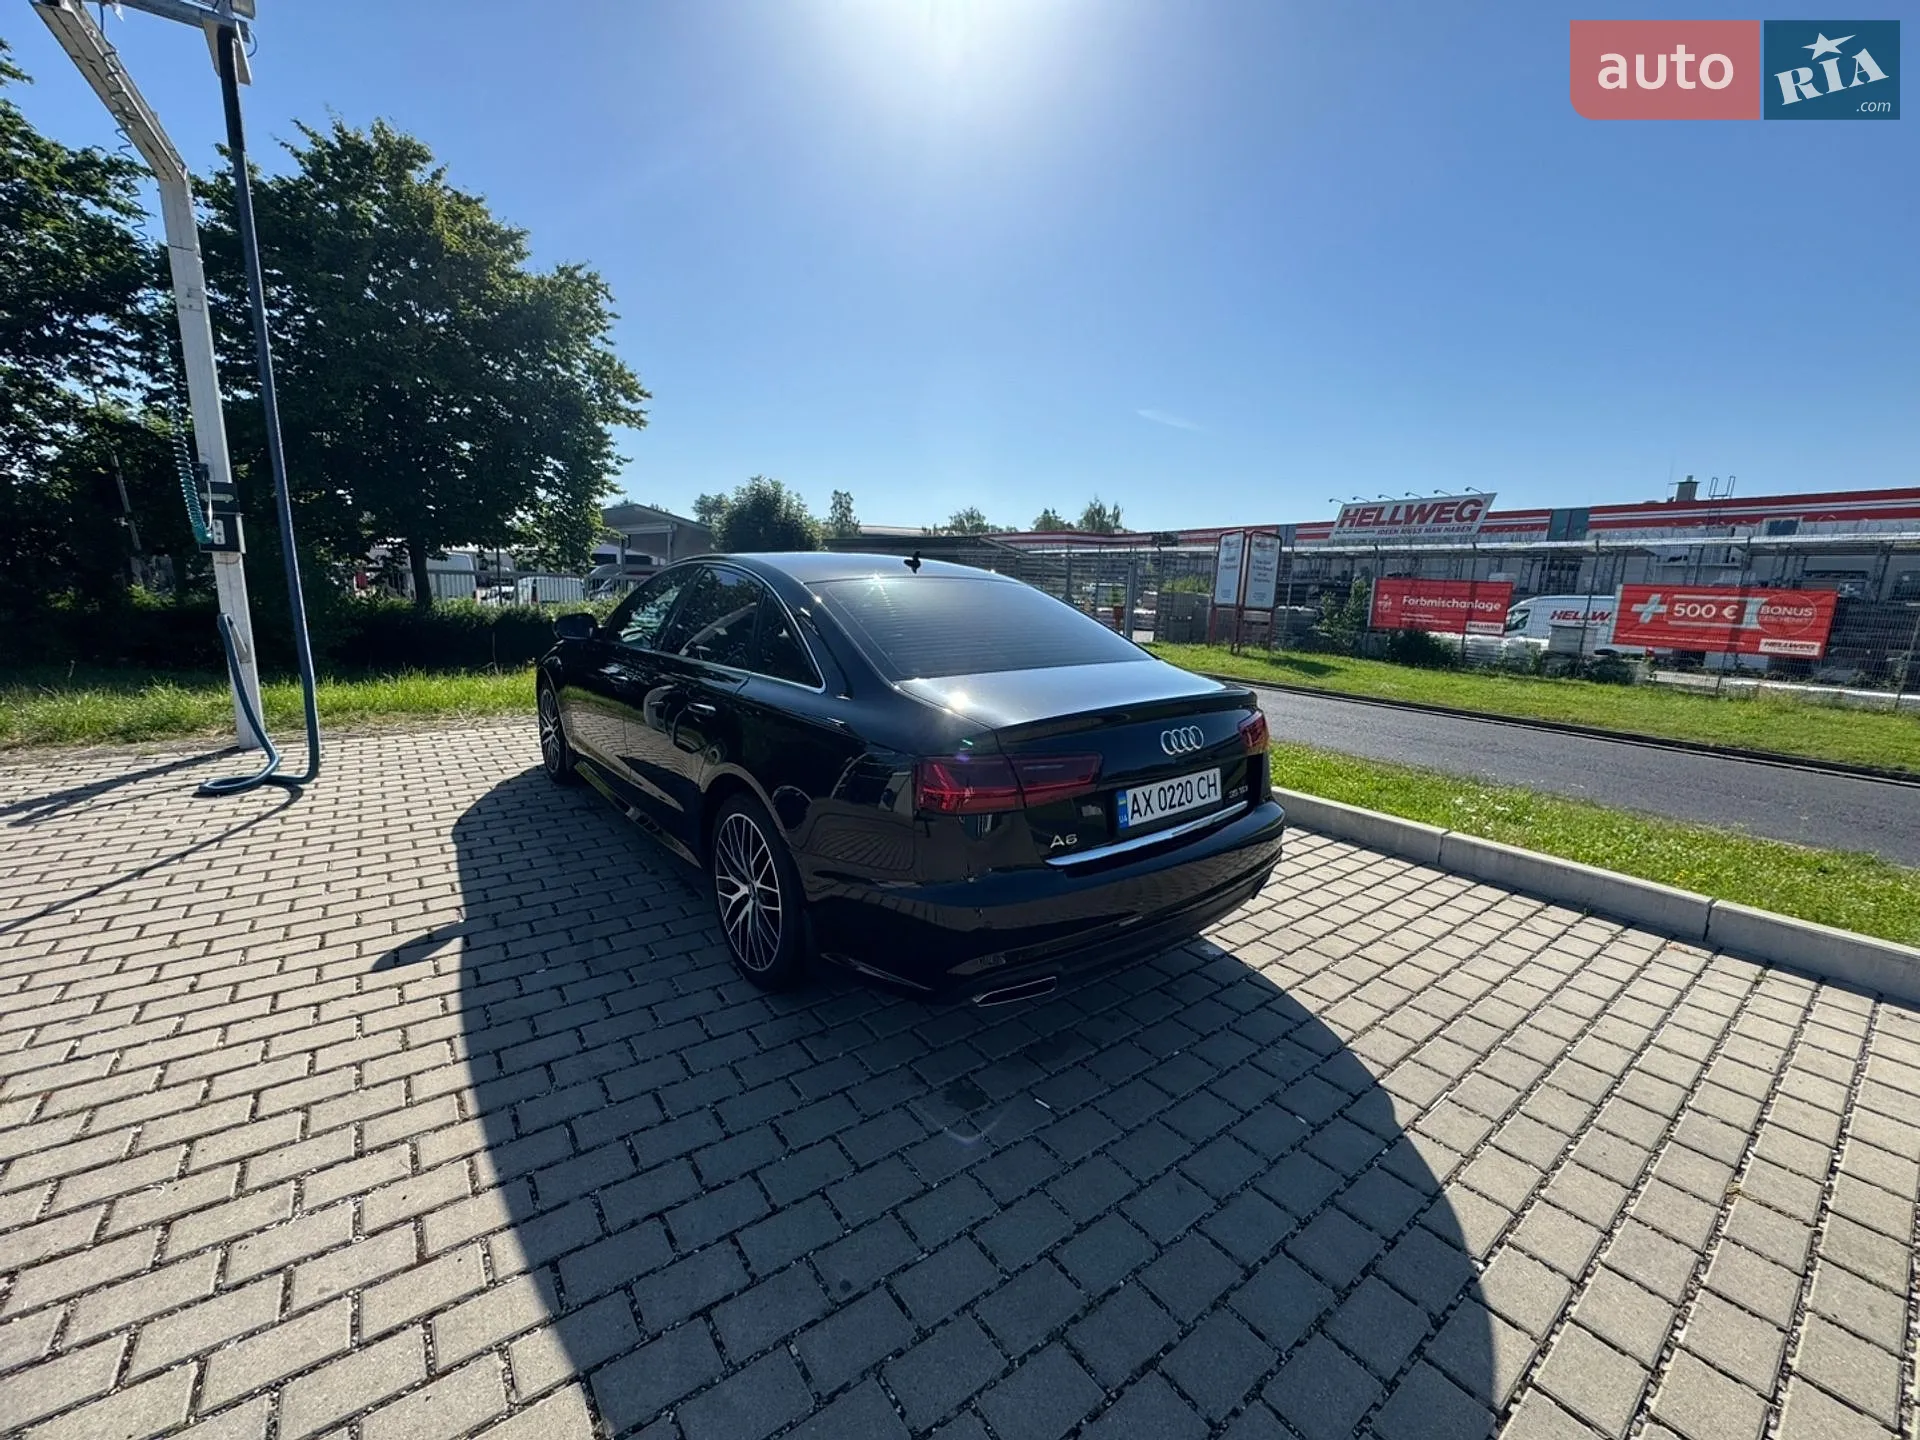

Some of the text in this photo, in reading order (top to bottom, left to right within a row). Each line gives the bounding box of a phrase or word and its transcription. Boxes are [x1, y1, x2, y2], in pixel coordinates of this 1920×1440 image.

[1338, 499, 1482, 528] HELLWEG
[1403, 595, 1501, 612] Farbmischanlage
[1673, 603, 1738, 620] 500 €
[1761, 605, 1813, 617] BONUS
[1764, 641, 1816, 650] HELLWEG
[1131, 773, 1218, 820] AX 0220 CH
[1050, 833, 1078, 849] A6
